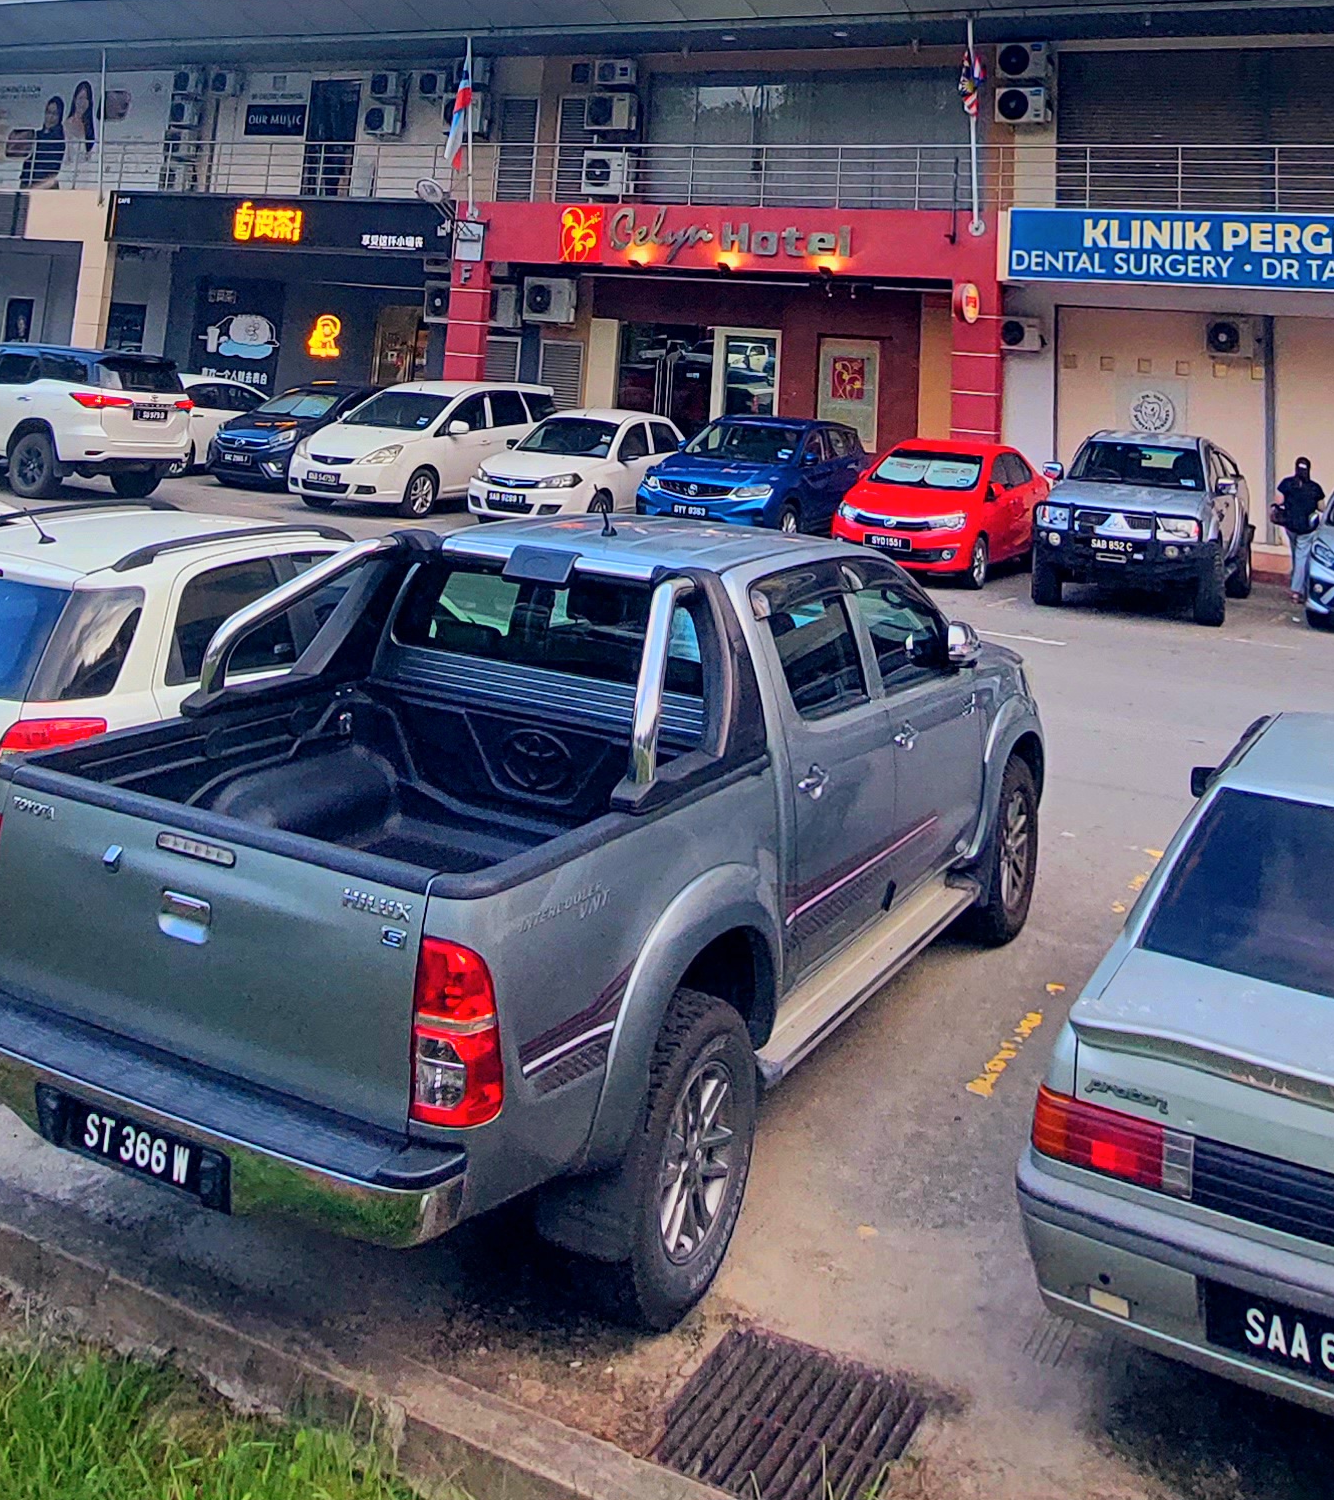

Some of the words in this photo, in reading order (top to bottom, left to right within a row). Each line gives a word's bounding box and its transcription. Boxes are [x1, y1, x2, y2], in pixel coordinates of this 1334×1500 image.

[249, 114, 268, 125] OUR
[270, 114, 303, 127] MUSIC
[609, 207, 714, 264] Celyn
[720, 221, 853, 258] Hotel
[1083, 218, 1212, 251] KLINIK
[460, 265, 472, 285] F
[1011, 250, 1107, 273] DENTAL
[1113, 253, 1234, 278] SURGERY
[1262, 258, 1300, 280] DR
[1091, 538, 1107, 549] SAB
[1108, 540, 1125, 551] 852
[1126, 542, 1133, 552] C
[13, 795, 55, 821] TOYOTA
[342, 887, 414, 924] HILUX
[1084, 1079, 1169, 1115] proton
[84, 1113, 116, 1154] ST
[119, 1125, 168, 1175] 366
[172, 1143, 191, 1185] W
[1244, 1307, 1312, 1364] SAA
